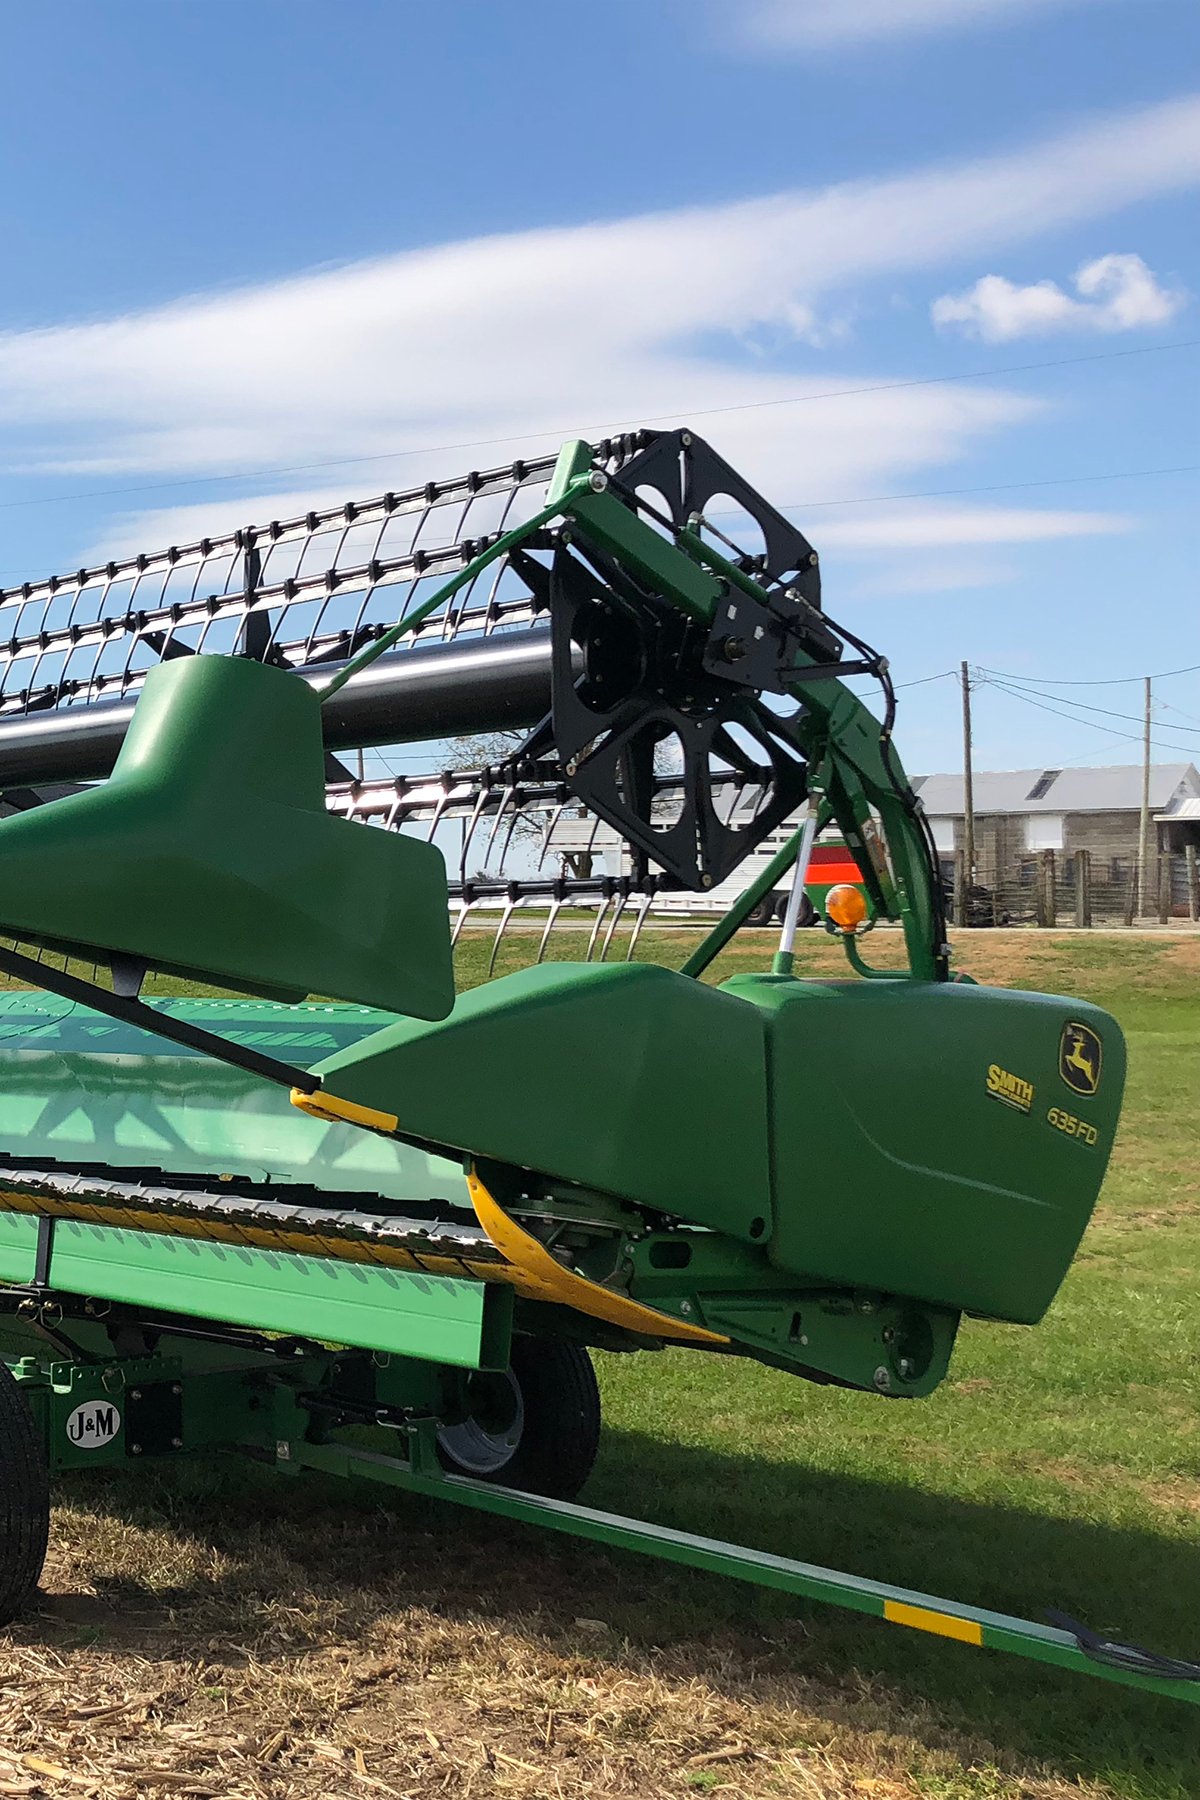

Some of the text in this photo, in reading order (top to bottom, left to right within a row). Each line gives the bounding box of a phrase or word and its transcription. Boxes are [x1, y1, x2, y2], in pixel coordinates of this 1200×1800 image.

[986, 1064, 1033, 1101] SMITH
[1047, 1107, 1098, 1145] 635FD
[69, 1407, 115, 1441] J&M
